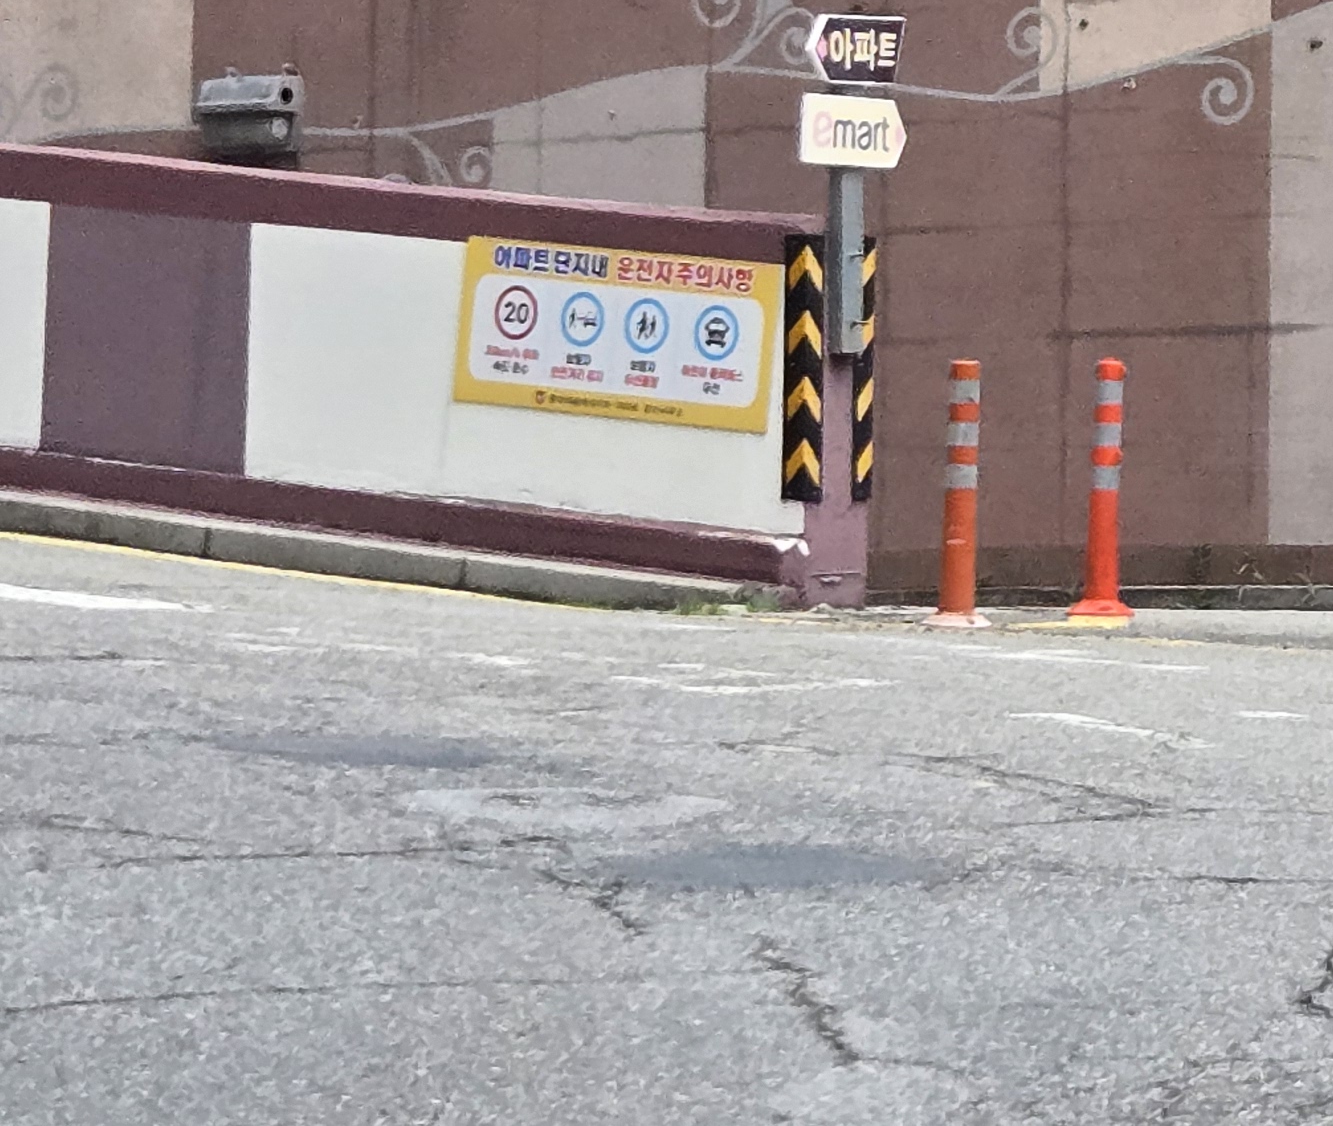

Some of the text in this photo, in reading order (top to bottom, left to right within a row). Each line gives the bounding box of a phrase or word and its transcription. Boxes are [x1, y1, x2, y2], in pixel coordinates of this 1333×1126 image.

[829, 27, 898, 71] 아파트
[811, 110, 891, 153] emart
[503, 301, 530, 325] 20
